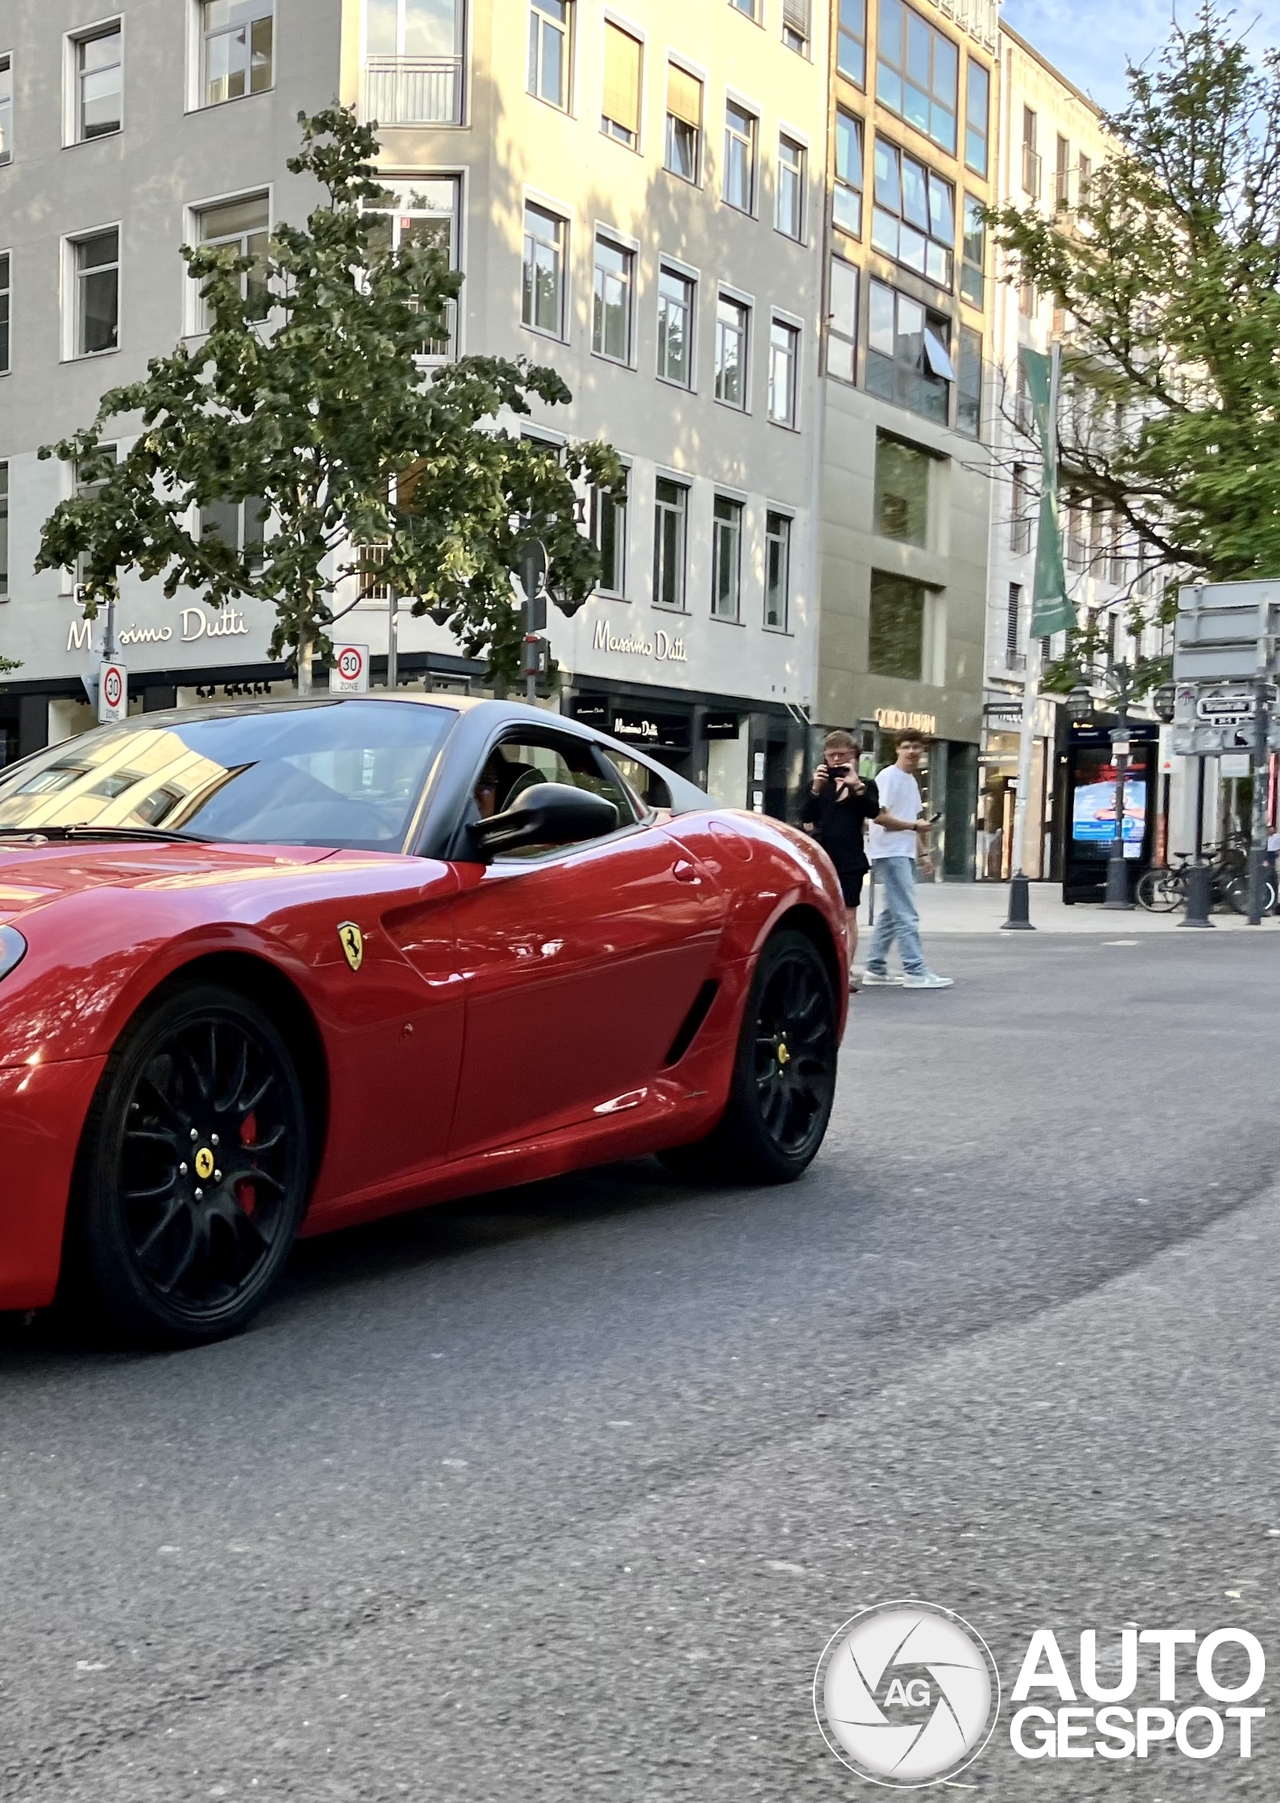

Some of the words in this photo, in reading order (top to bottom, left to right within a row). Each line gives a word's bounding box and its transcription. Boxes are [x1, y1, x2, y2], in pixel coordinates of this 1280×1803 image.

[67, 618, 173, 651] Msimo
[179, 607, 249, 642] Dutti
[593, 620, 653, 656] Massimo
[654, 629, 688, 662] Dutti
[342, 656, 357, 672] 30
[107, 677, 119, 696] 30
[340, 681, 359, 691] ZONE
[105, 708, 120, 720] ZONE
